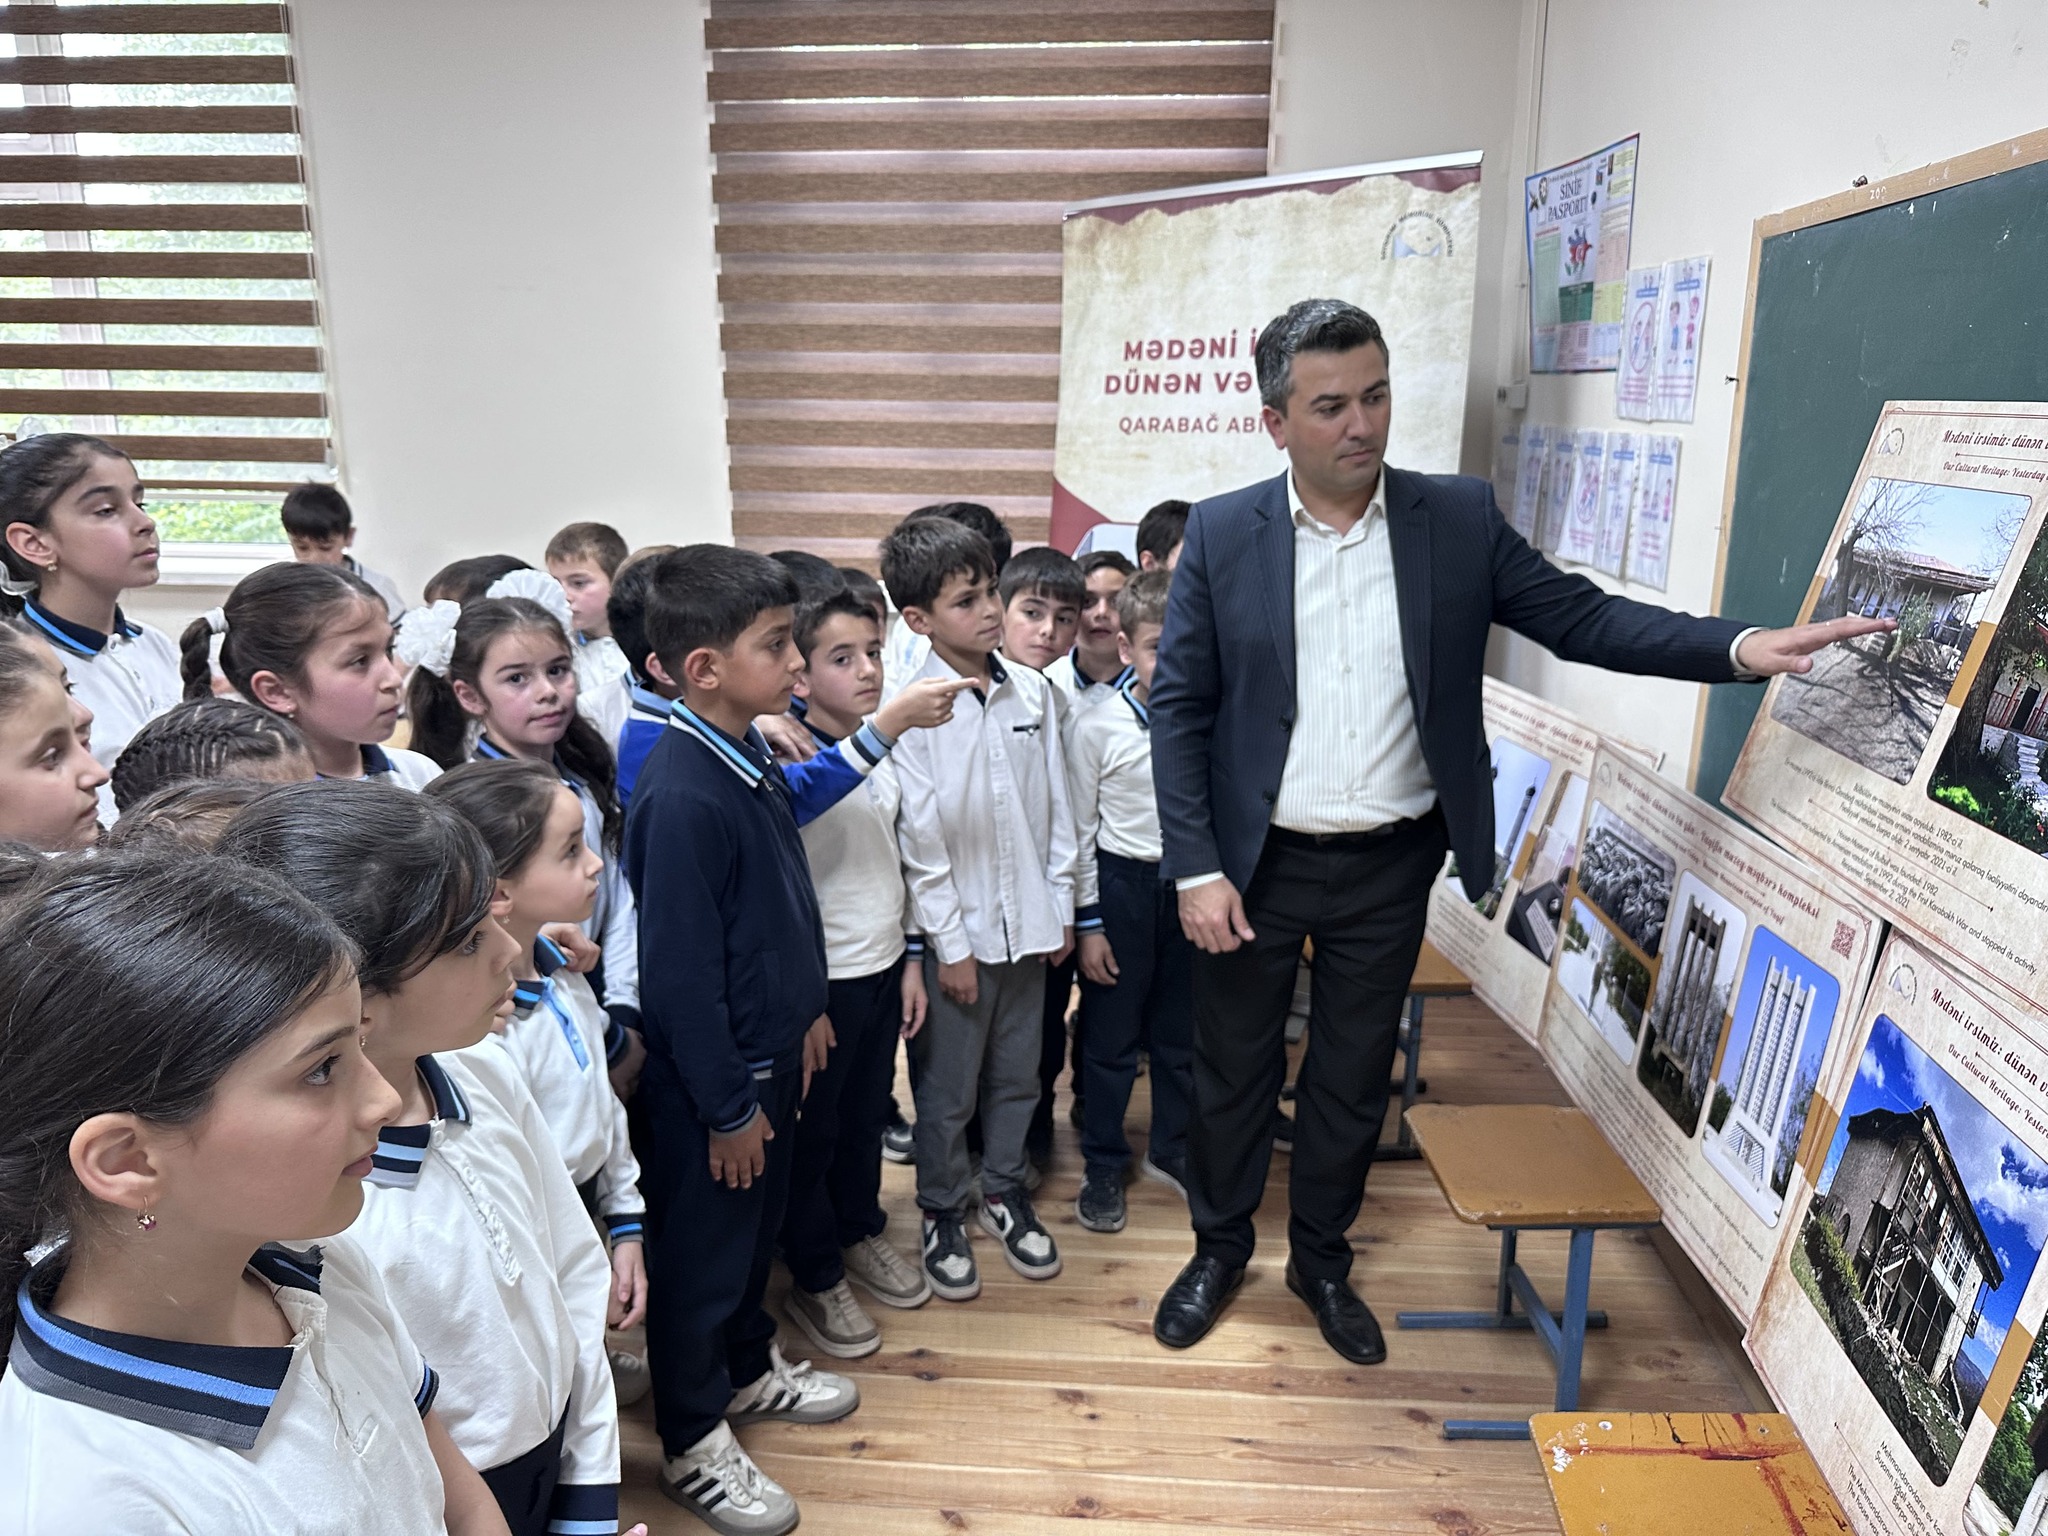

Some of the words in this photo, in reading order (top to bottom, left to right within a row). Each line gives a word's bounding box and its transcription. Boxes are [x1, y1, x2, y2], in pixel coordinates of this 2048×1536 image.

[1124, 330, 1237, 361] MƏDƏNİ
[1105, 370, 1201, 395] DÜNƏN
[1214, 372, 1253, 392] VƏ
[1118, 413, 1219, 434] QARABAĞ
[1943, 430, 1974, 444] Mədəni
[2012, 434, 2043, 449] dünən
[1943, 462, 1954, 470] Our
[1955, 462, 1980, 473] Cultural
[1981, 464, 2010, 478] Heritage:
[2012, 468, 2045, 482] Yesterday
[1936, 828, 1957, 846] 1982-ci
[1922, 881, 1938, 896] 1982
[1962, 860, 1985, 879] qalaraq
[1986, 870, 2019, 895] fəaliyyətini
[1778, 885, 1819, 918] kompleksi
[1895, 893, 1910, 908] 2021
[1878, 868, 1893, 883] 1992
[1892, 878, 1908, 895] during
[1909, 888, 1917, 898] the
[1917, 892, 1929, 905] First
[1928, 900, 1954, 921] Karabakh
[1956, 916, 1968, 930] War
[1968, 926, 1983, 939] and
[1981, 935, 2007, 954] stopped
[2006, 948, 2014, 960] its
[2014, 956, 2038, 976] activity.
[1931, 988, 1964, 1024] Mədəni
[1964, 1016, 2003, 1055] irsimiz:
[2004, 1052, 2037, 1086] dünən
[1948, 1044, 1960, 1059] Our
[1961, 1055, 1989, 1084] Cultural
[1989, 1080, 2021, 1113] Heritage:
[1848, 1463, 1856, 1480] The
[1848, 1480, 1856, 1498] The
[1856, 1495, 1869, 1521] house
[1906, 1501, 1925, 1531] zamanı
[1926, 1512, 1934, 1522] ev
